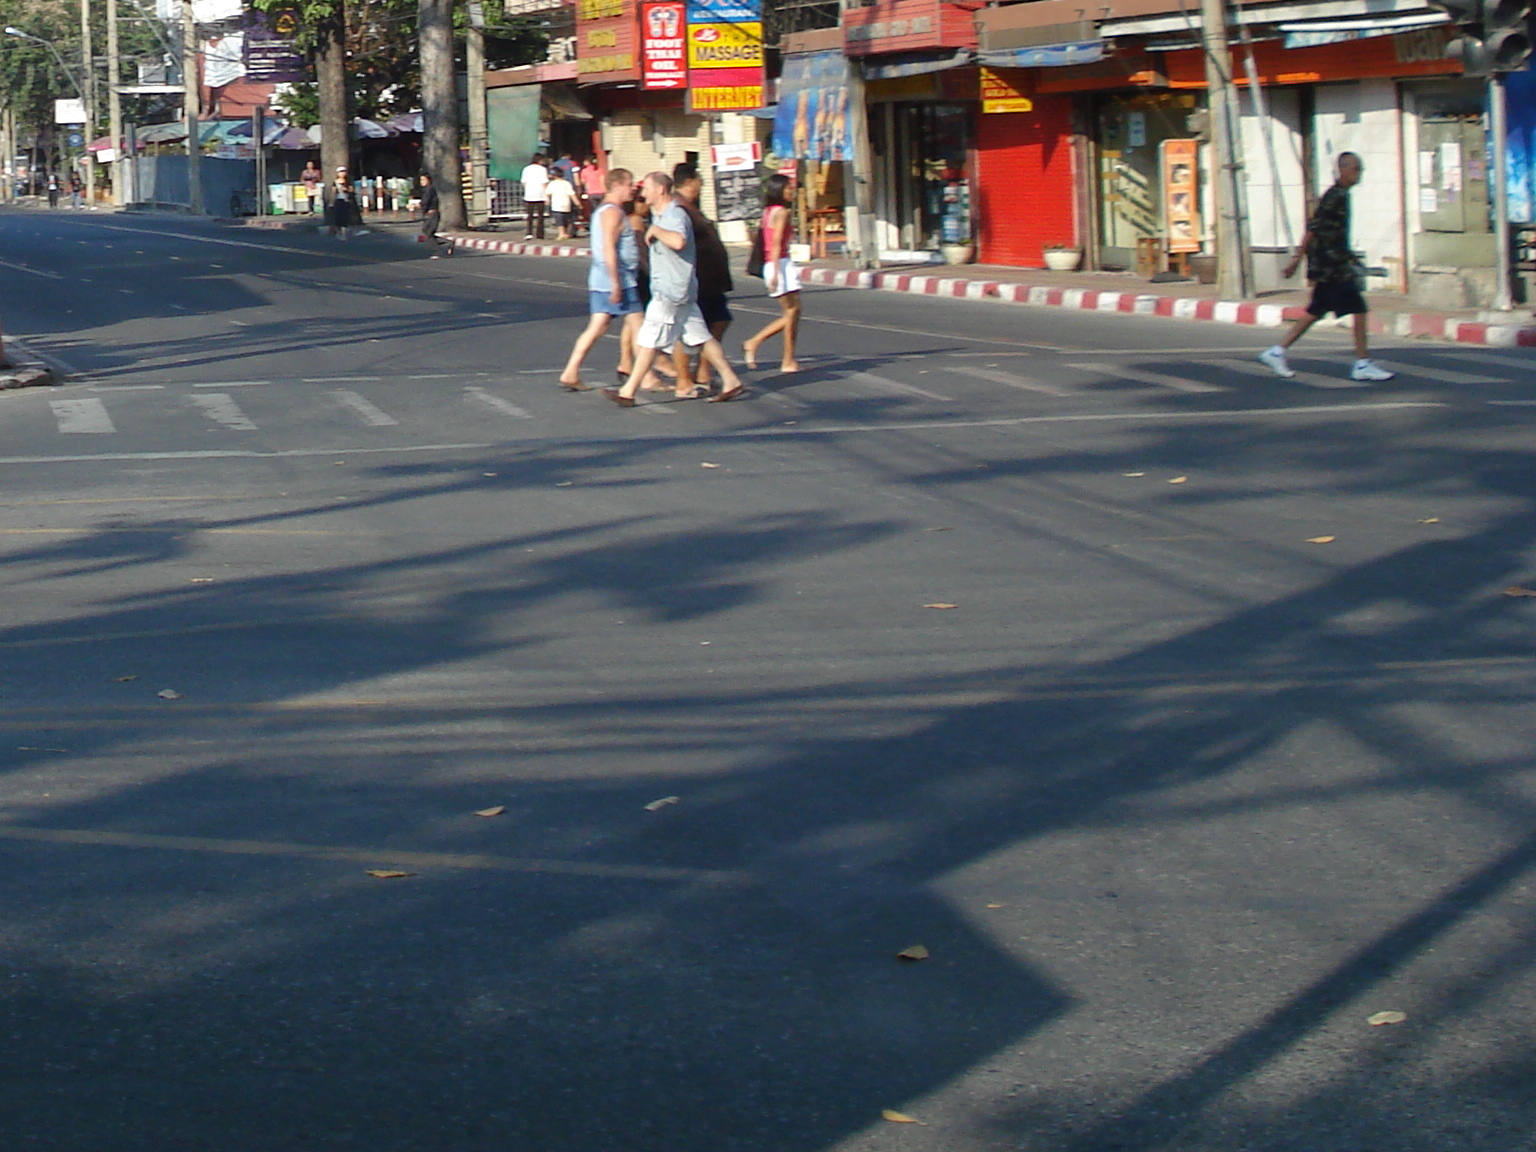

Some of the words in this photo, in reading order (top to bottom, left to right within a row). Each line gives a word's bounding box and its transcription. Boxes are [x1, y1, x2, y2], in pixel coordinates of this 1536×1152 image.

[645, 38, 684, 49] FOOT
[645, 49, 683, 60] THAI
[695, 44, 762, 62] MASSAGE
[650, 60, 680, 71] OIL
